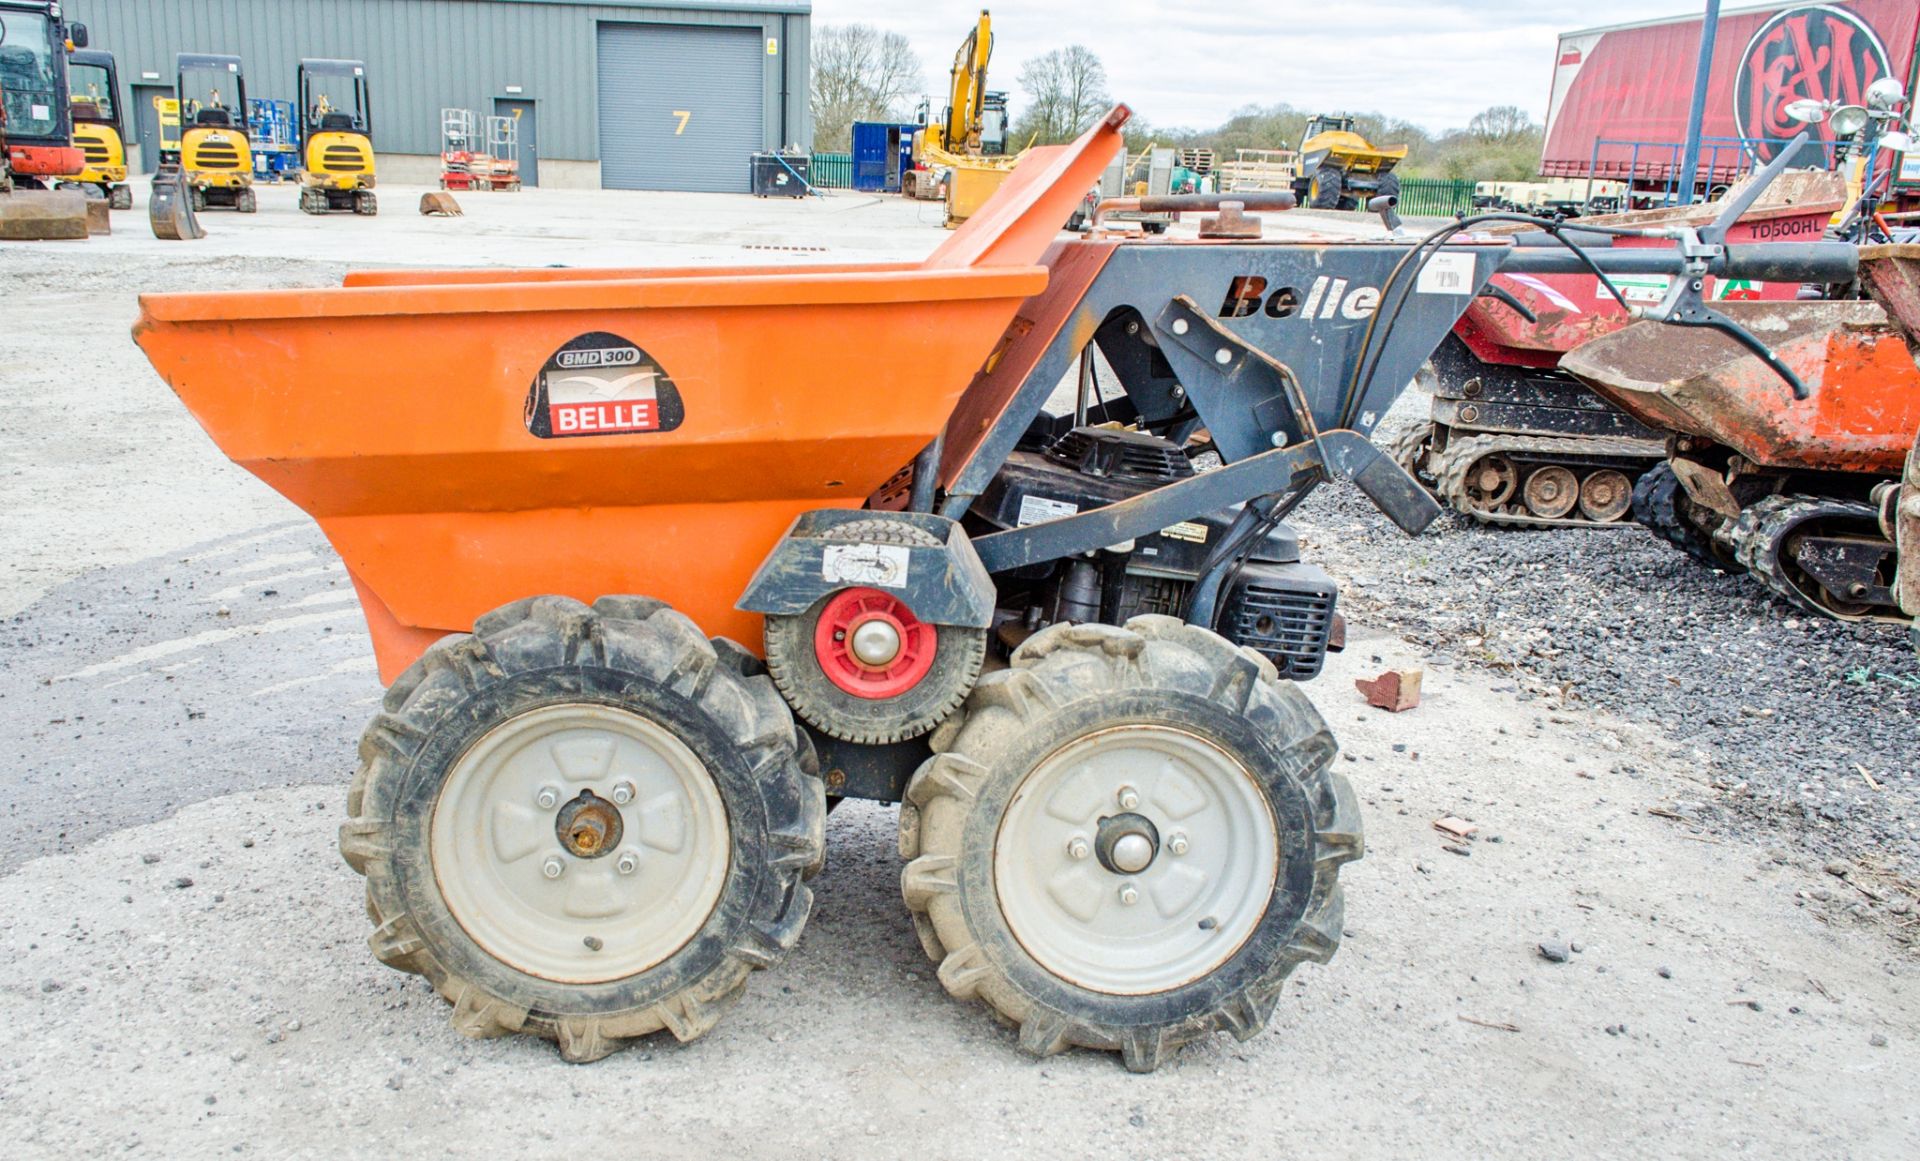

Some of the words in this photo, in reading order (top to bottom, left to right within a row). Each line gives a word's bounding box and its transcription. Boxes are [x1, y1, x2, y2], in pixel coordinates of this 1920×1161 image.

[511, 109, 523, 122] 7
[672, 111, 691, 135] 7
[204, 134, 229, 142] JCB
[1751, 220, 1821, 239] TD500HL
[1218, 276, 1381, 319] Belle
[563, 352, 600, 365] BMD
[605, 350, 635, 362] 300
[558, 404, 649, 431] BELLE
